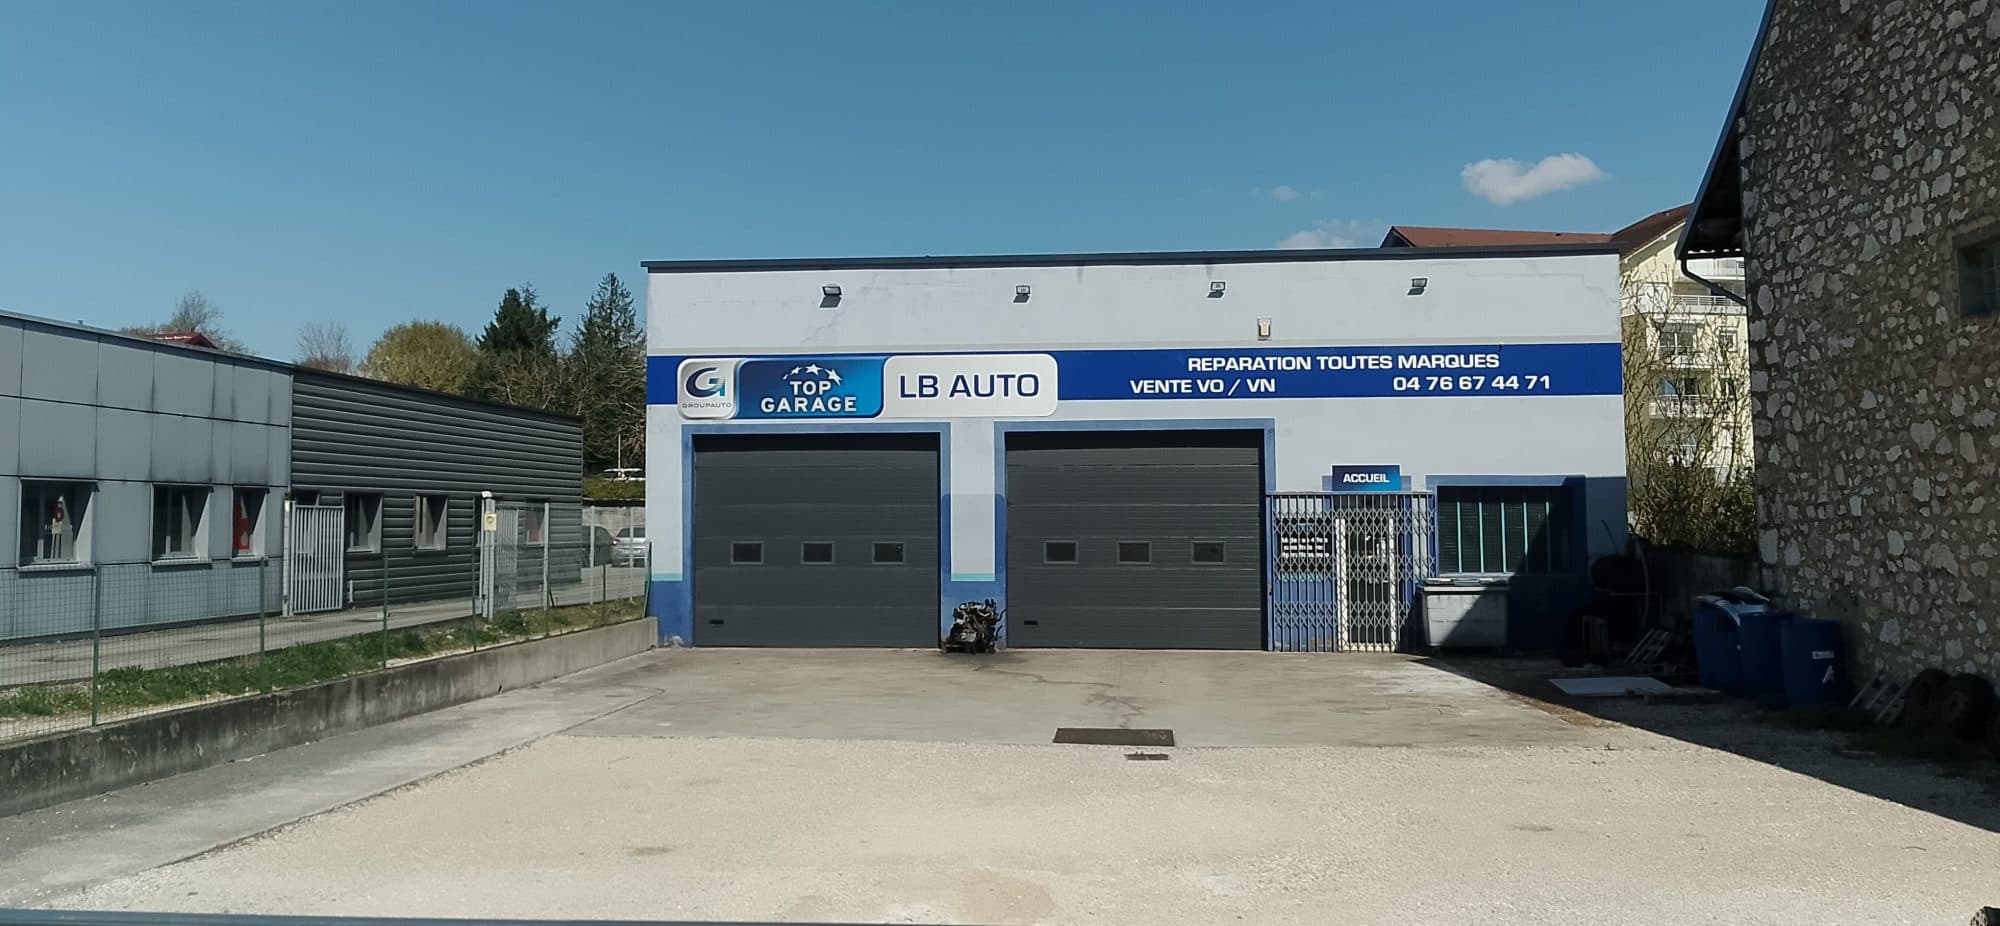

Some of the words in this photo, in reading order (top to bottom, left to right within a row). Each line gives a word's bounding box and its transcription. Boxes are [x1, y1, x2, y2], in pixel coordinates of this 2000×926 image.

[1187, 356, 1312, 372] REPARATION
[1316, 355, 1393, 371] TOUTES
[1398, 353, 1500, 369] MARQUES
[789, 380, 831, 396] TOP
[900, 375, 939, 399] LB
[948, 373, 1039, 398] AUTO
[1130, 379, 1192, 394] VENTE
[1196, 379, 1225, 393] VO
[1228, 378, 1240, 397] /
[1246, 378, 1276, 393] VN
[1393, 376, 1421, 391] 04
[1425, 376, 1453, 391] 76
[1458, 375, 1486, 390] 67
[1491, 375, 1520, 390] 44
[1524, 375, 1551, 390] 71
[760, 396, 857, 413] GARAGE
[1342, 473, 1391, 483] ACCUEIL
